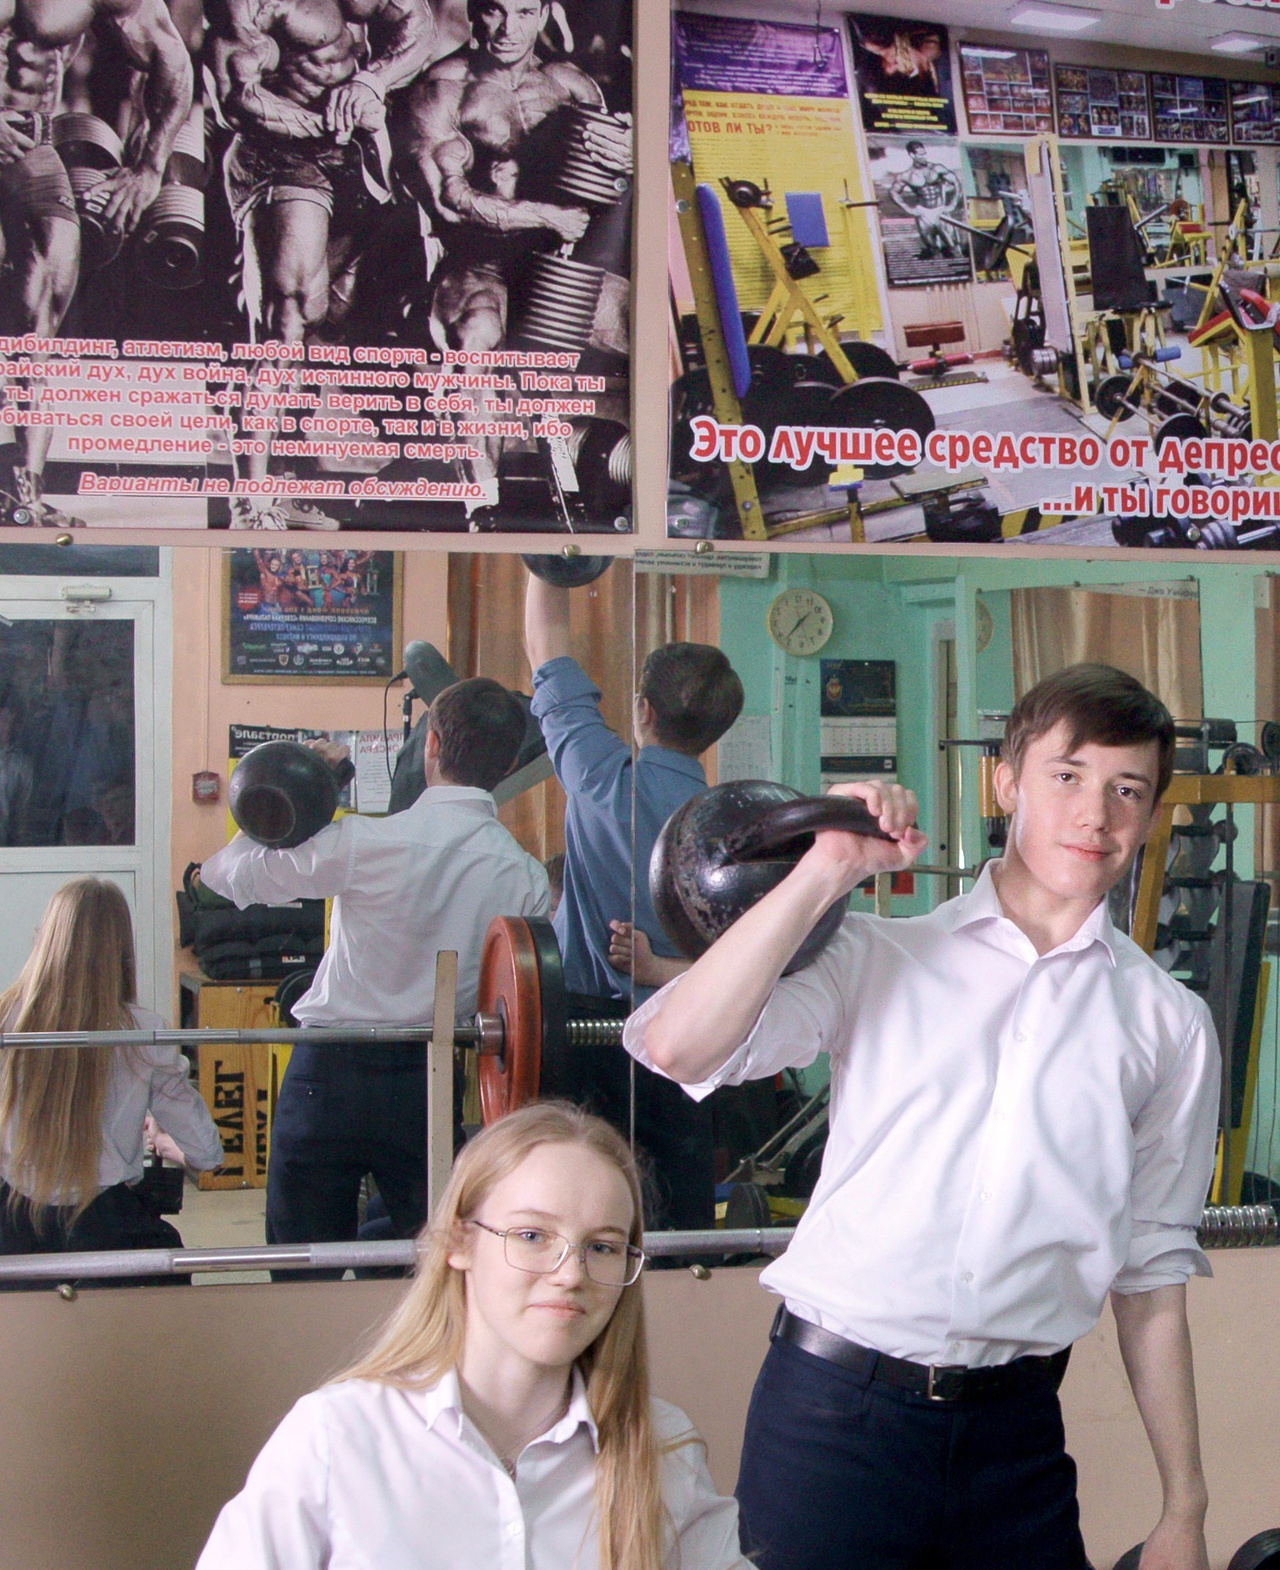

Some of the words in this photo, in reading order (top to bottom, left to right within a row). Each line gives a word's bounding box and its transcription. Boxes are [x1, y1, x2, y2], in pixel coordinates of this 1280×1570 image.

[124, 341, 227, 361] атлетизм,
[233, 342, 303, 360] любой
[310, 347, 349, 364] вид
[355, 350, 426, 366] спорта
[445, 352, 580, 368] воспитывает
[87, 365, 131, 382] дух,
[138, 365, 177, 382] дух
[183, 364, 252, 384] война,
[258, 370, 296, 386] дух
[302, 371, 409, 388] истинного
[414, 373, 516, 393] мужчины.
[521, 373, 571, 391] Пока
[576, 377, 606, 392] ты
[5, 386, 34, 401] ты
[41, 388, 121, 404] должен
[128, 390, 240, 408] сражаться
[246, 393, 321, 410] думать
[328, 395, 401, 413] верить
[407, 397, 420, 410] в
[425, 394, 479, 415] себя,
[485, 399, 512, 413] ты
[517, 400, 595, 415] должен
[0, 407, 103, 427] биваться
[110, 410, 173, 429] своей
[180, 415, 237, 433] цели,
[243, 417, 278, 431] как
[282, 418, 296, 431] в
[300, 417, 379, 437] спорте,
[383, 420, 418, 435] так
[422, 422, 435, 436] и
[441, 422, 453, 436] в
[458, 422, 529, 439] жизни,
[533, 420, 572, 438] ибо
[67, 436, 212, 455] промедление
[232, 439, 266, 454] это
[272, 441, 399, 459] неминуемая
[404, 443, 485, 462] смерть.
[693, 419, 763, 459] Это
[772, 430, 918, 467] лучшее
[928, 433, 1099, 469] средство
[1109, 438, 1148, 468] от
[79, 471, 199, 493] Варианты
[202, 478, 230, 493] не
[233, 477, 344, 496] подлежат
[348, 477, 487, 498] обсуждению.
[1103, 487, 1148, 513] ты
